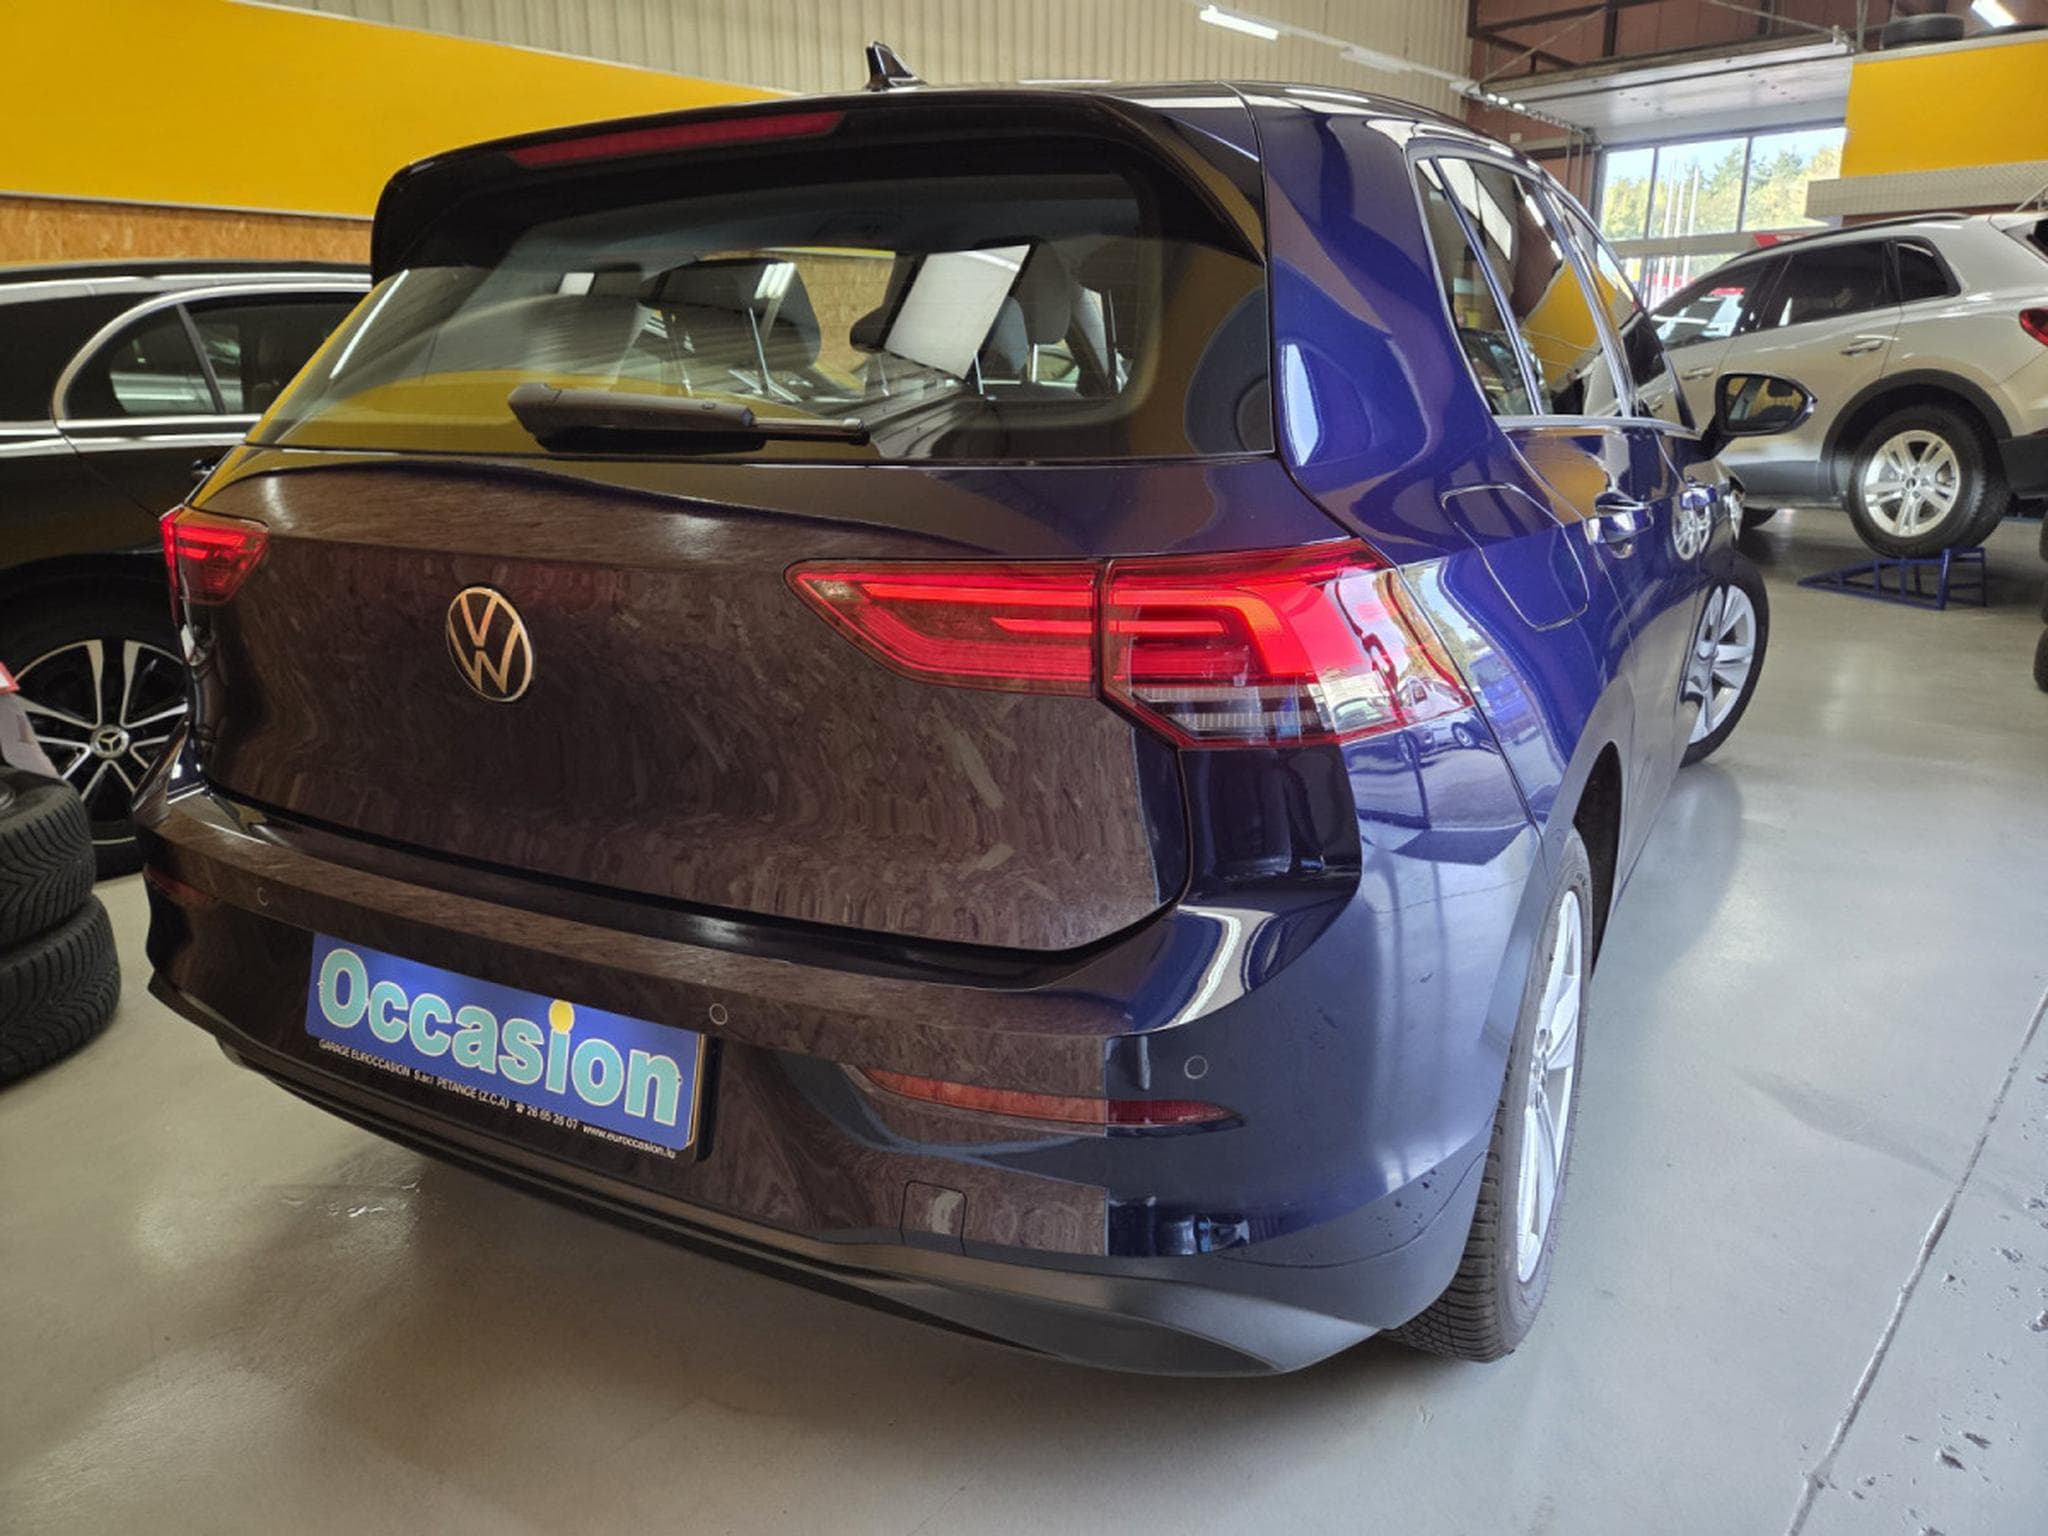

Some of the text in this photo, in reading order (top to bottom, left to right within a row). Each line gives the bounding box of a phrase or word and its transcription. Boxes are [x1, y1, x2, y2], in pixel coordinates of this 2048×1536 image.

[318, 947, 683, 1127] Occasion
[319, 1038, 351, 1058] GARAGE
[350, 1048, 411, 1078] EUROCCASION
[436, 1076, 477, 1099] PETANGE
